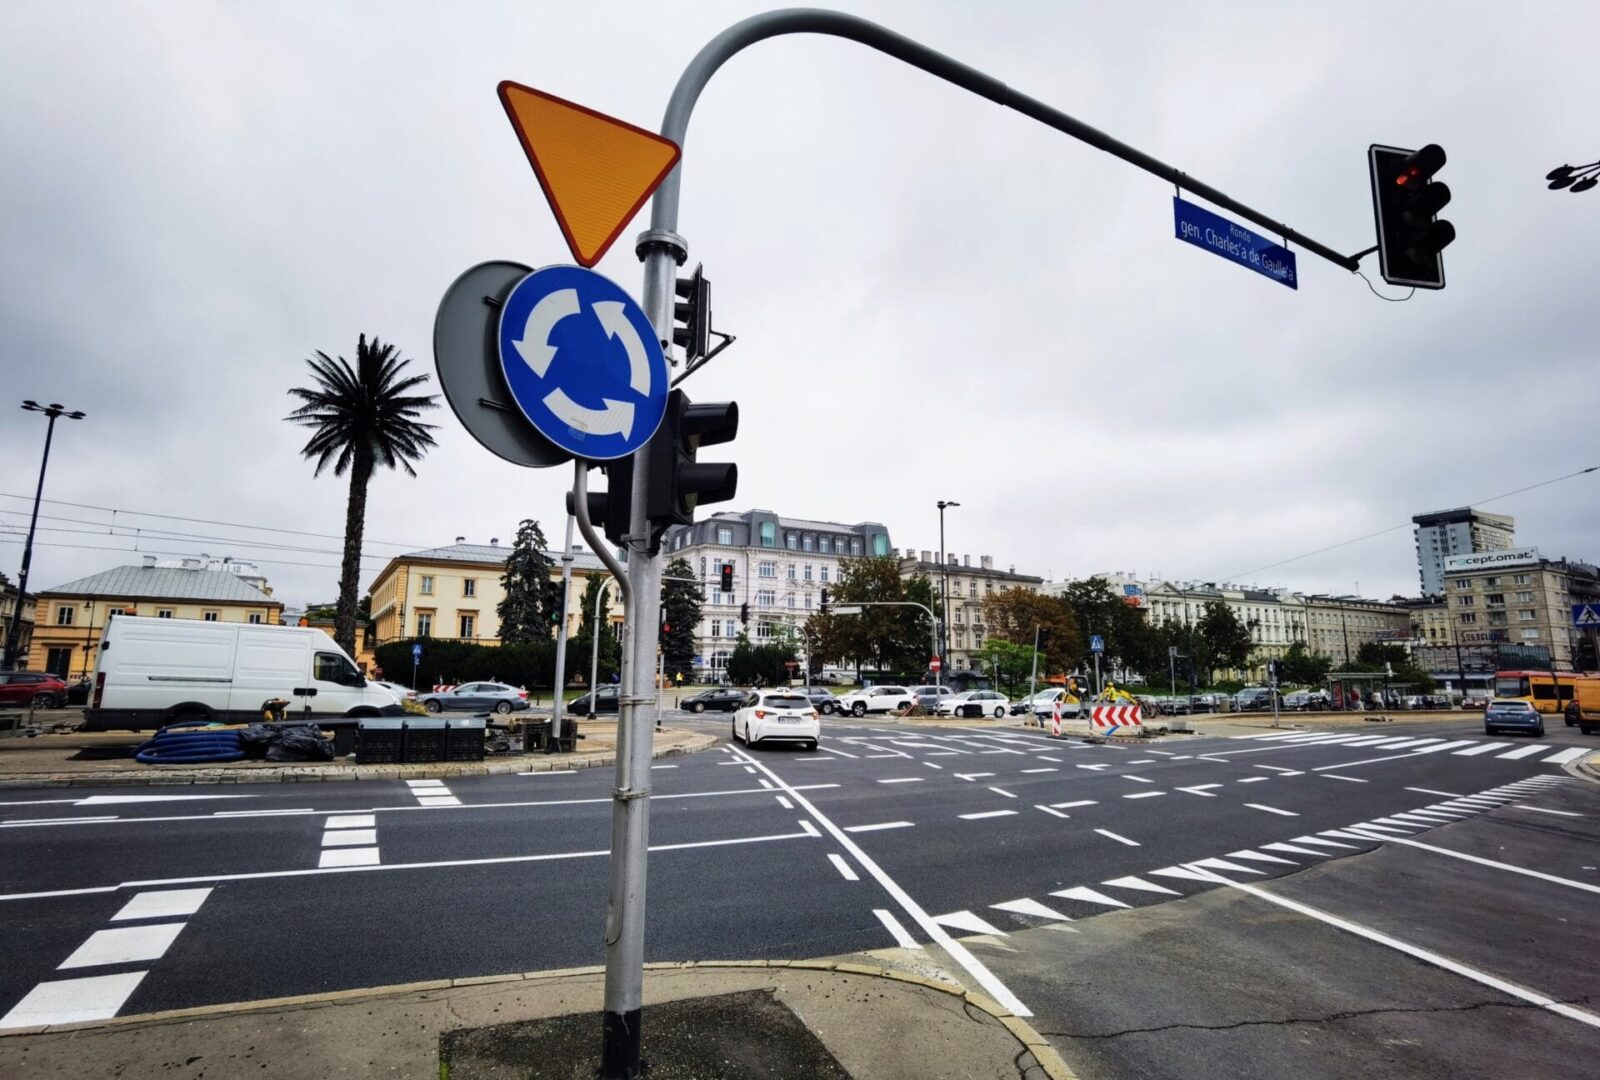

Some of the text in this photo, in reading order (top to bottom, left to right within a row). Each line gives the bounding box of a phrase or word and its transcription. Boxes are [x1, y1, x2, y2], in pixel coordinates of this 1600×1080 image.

[1181, 220, 1294, 281] gen. Charles'a de Gaulle'a
[1230, 224, 1251, 242] Rondo
